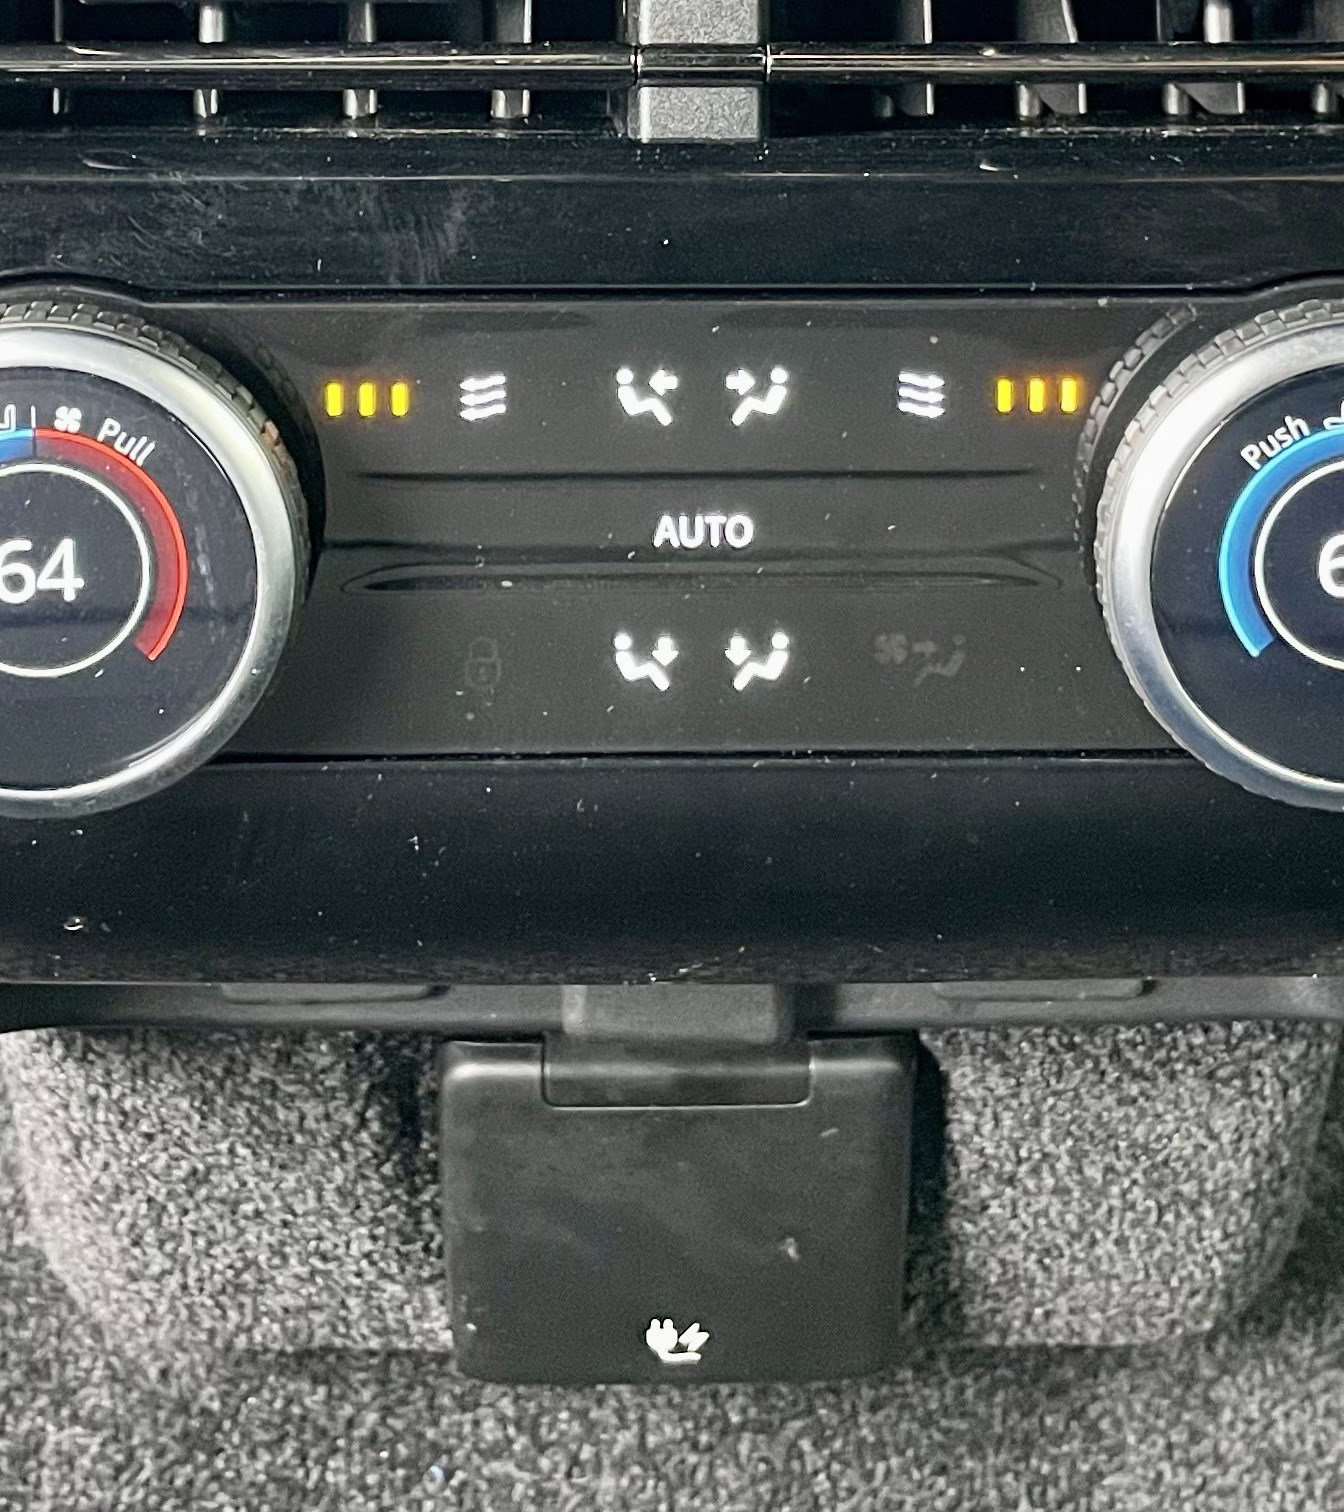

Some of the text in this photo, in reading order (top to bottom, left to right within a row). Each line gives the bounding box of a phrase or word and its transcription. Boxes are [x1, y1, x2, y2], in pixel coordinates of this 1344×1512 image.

[97, 420, 156, 466] Pull
[1241, 415, 1310, 469] Push
[654, 514, 755, 548] AUTO
